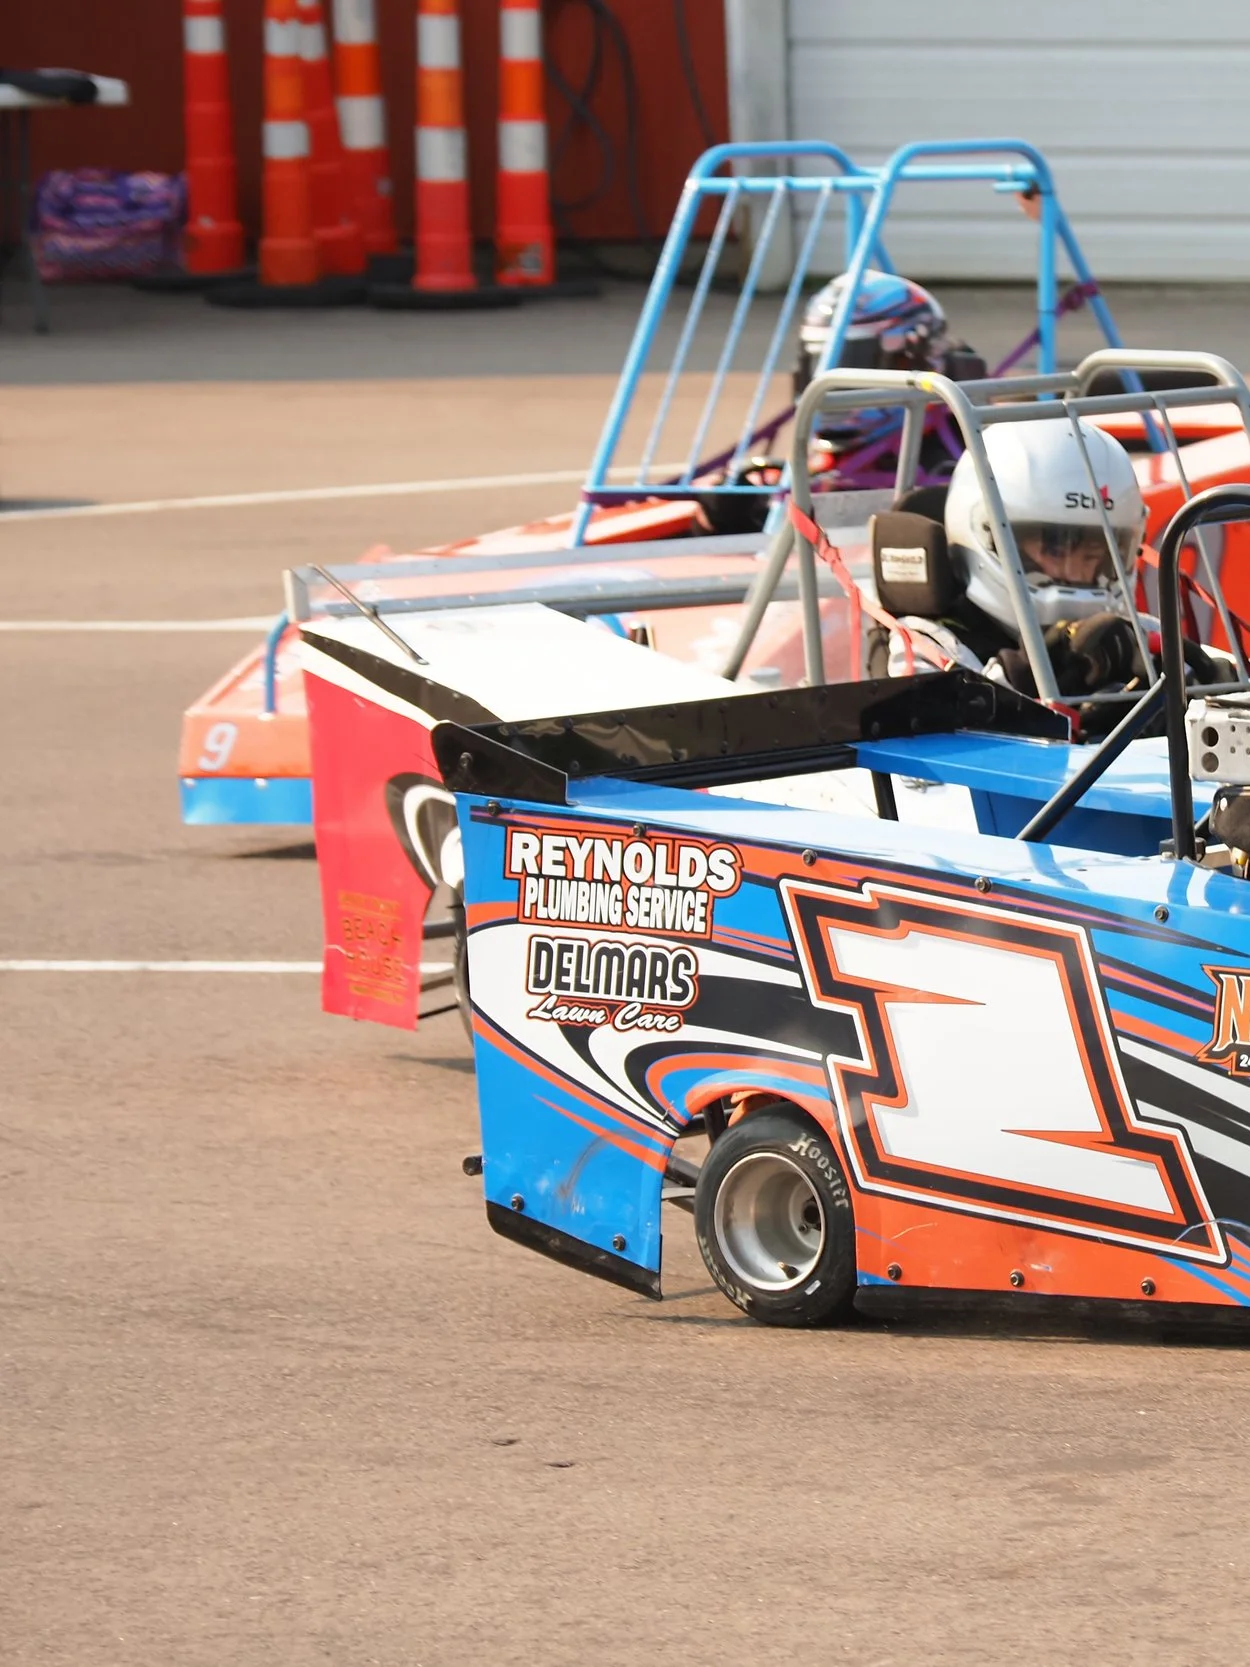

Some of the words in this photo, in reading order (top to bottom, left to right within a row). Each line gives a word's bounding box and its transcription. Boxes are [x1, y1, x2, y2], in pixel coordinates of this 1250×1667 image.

[198, 722, 238, 772] 9
[511, 833, 737, 891] REYNOLDS
[524, 878, 623, 923] PLUMBING
[626, 888, 709, 933] SERVICE
[533, 939, 695, 1002] DELMARS
[530, 995, 606, 1025] Lawn
[613, 1003, 681, 1032] Care
[794, 890, 1220, 1255] 1
